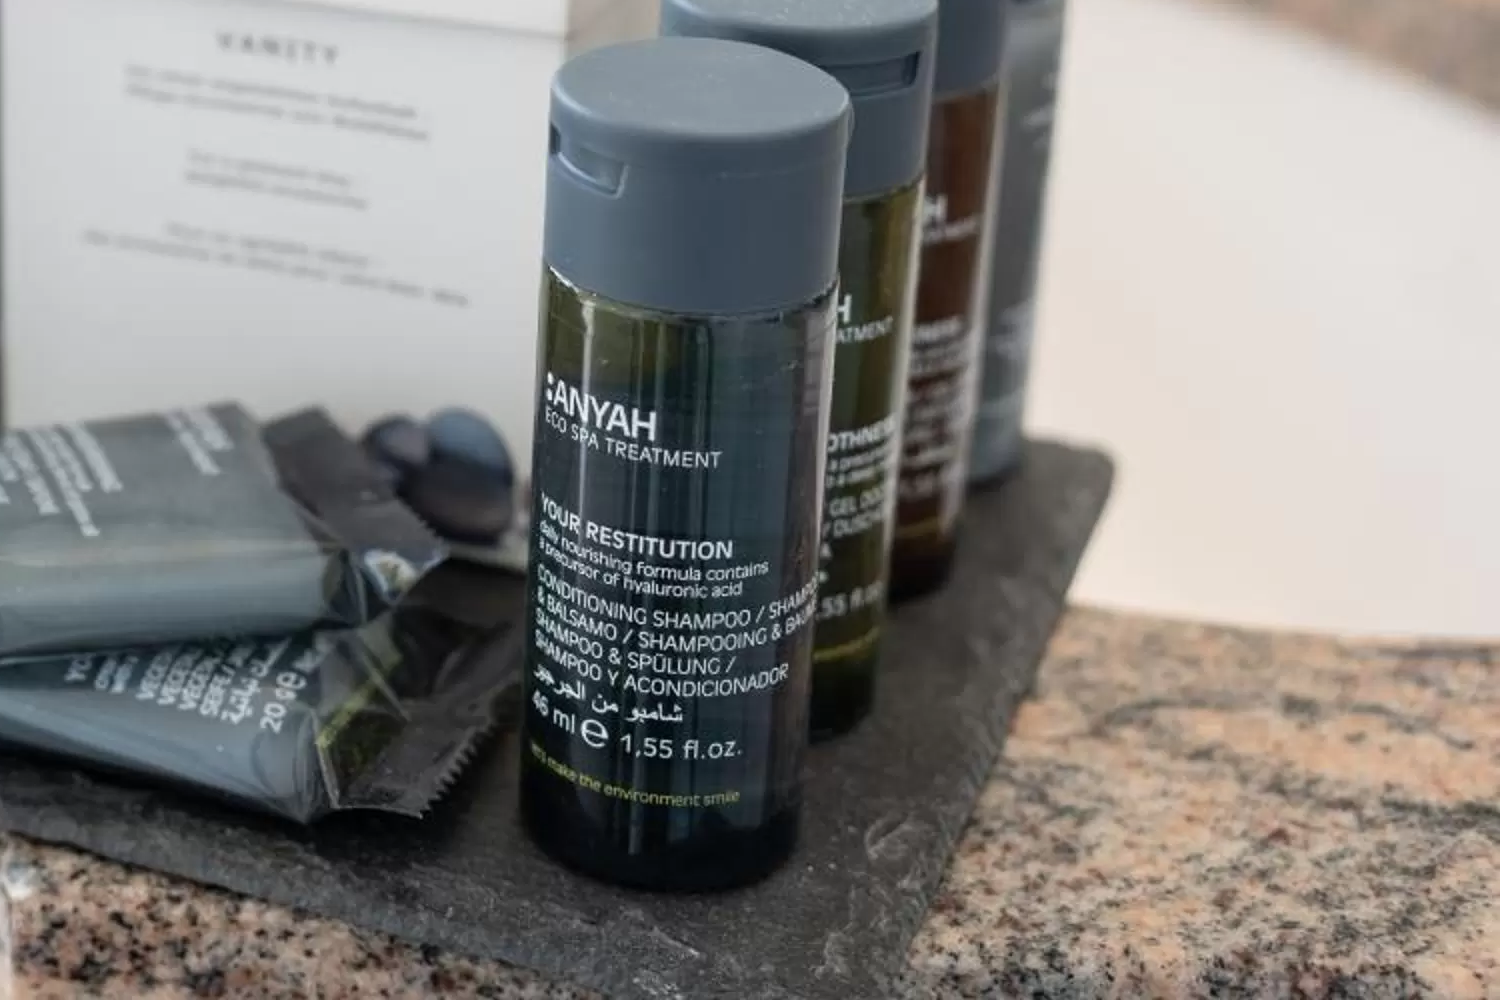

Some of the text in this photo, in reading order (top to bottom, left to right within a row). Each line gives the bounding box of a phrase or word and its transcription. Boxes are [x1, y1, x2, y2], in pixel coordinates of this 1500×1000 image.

[214, 31, 341, 65] VANITY
[545, 403, 723, 468] ECO SPA TREATMENT
[541, 490, 733, 560] YOUR RESTITUTION
[561, 537, 633, 575] nourishing
[636, 561, 701, 581] formula
[705, 561, 769, 581] contains
[602, 572, 620, 587] of
[623, 576, 708, 599] hyaluronic
[711, 580, 743, 599] acid
[537, 563, 648, 626] CONDITIONING
[652, 609, 751, 631] SHAMPOO
[755, 605, 765, 624] /
[546, 593, 618, 641] BALSAMO
[622, 628, 634, 645] /
[638, 627, 768, 653] SHAMPOOING
[771, 623, 782, 641] &
[534, 628, 789, 698] SHAMPOO Y ACONDICIONADOR
[535, 607, 737, 676] SHAMPOO & SPÜLUNG /
[260, 702, 287, 733] 20
[553, 708, 575, 734] ml
[620, 733, 673, 760] 1,55
[603, 783, 700, 808] environment
